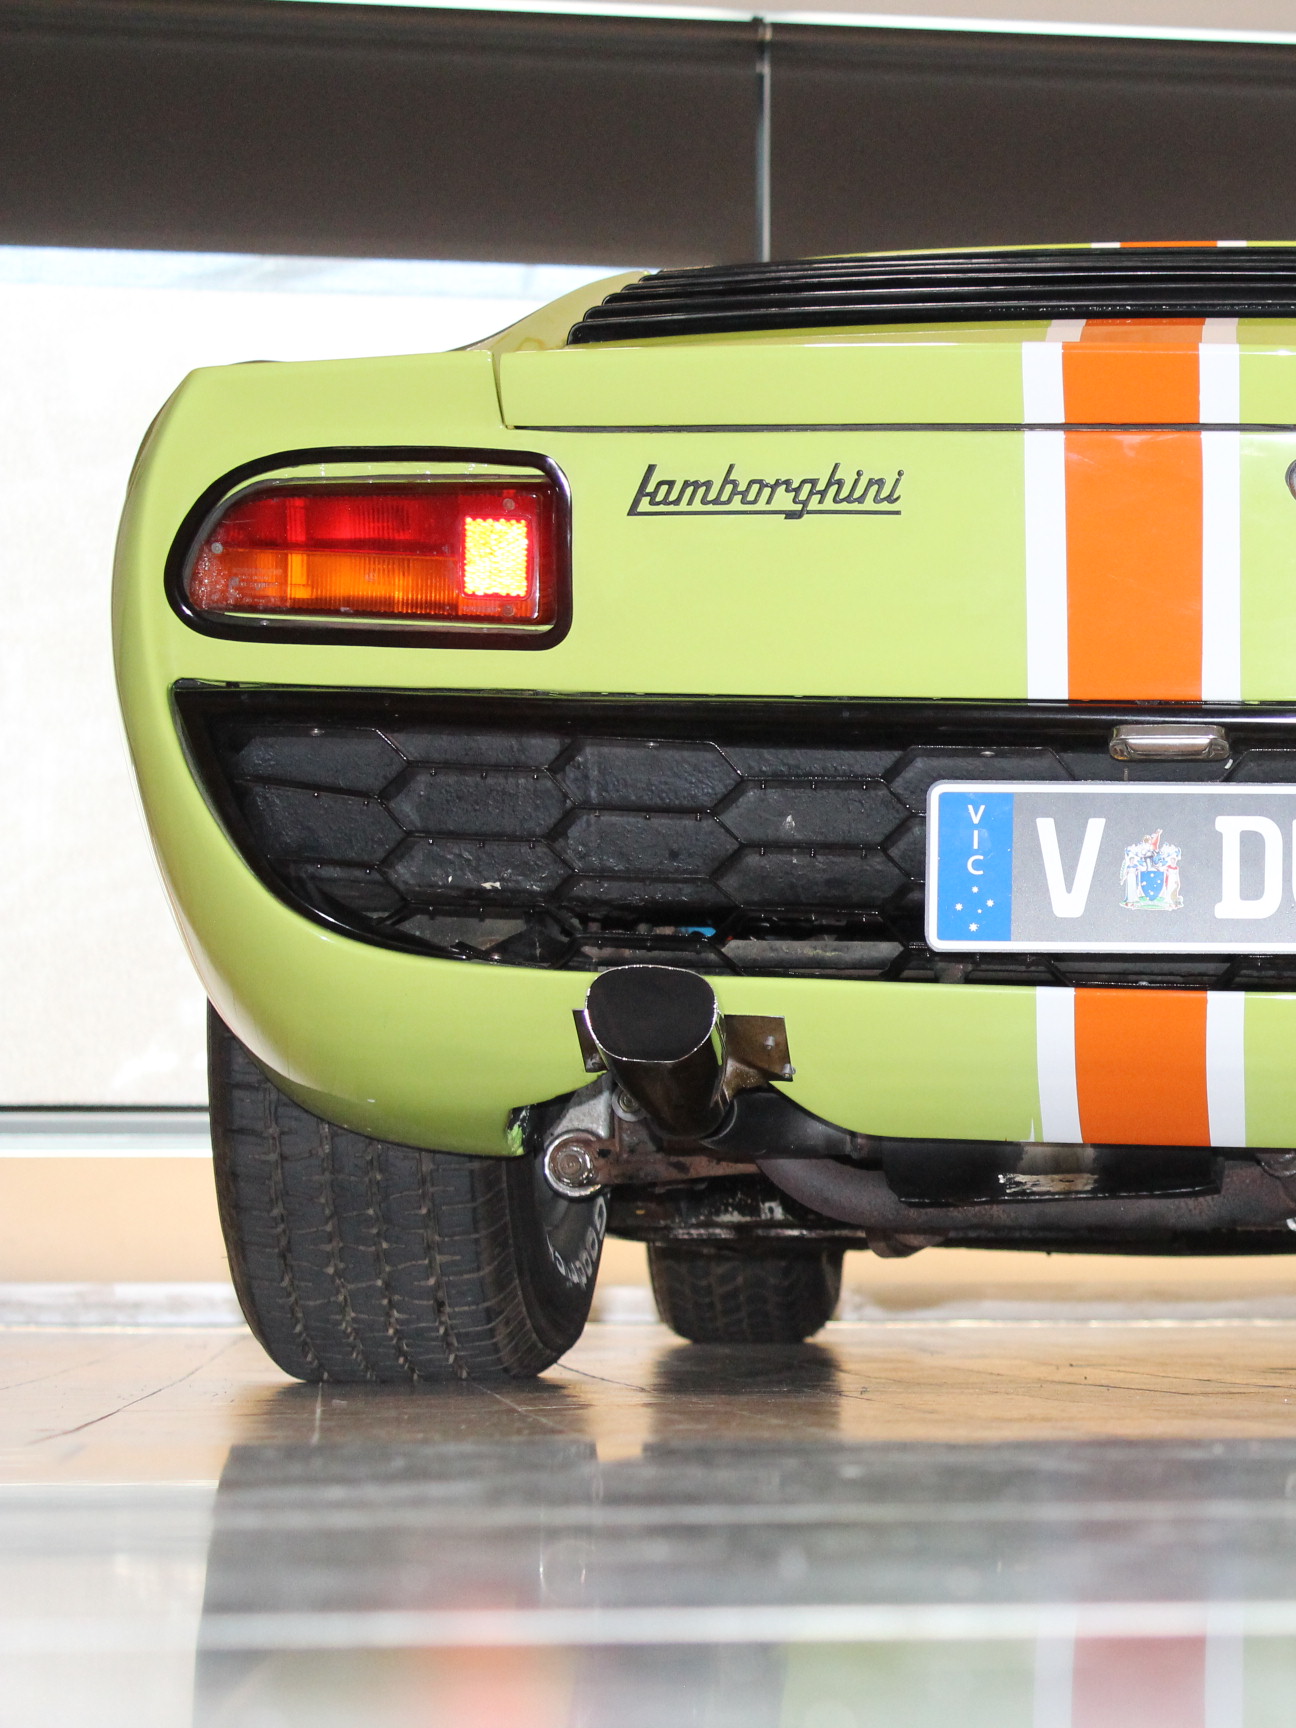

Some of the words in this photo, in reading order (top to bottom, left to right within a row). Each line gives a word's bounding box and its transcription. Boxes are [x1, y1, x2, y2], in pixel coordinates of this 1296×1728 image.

[626, 462, 905, 520] Lamborghini
[966, 803, 987, 876] VIC
[1035, 816, 1106, 919] V
